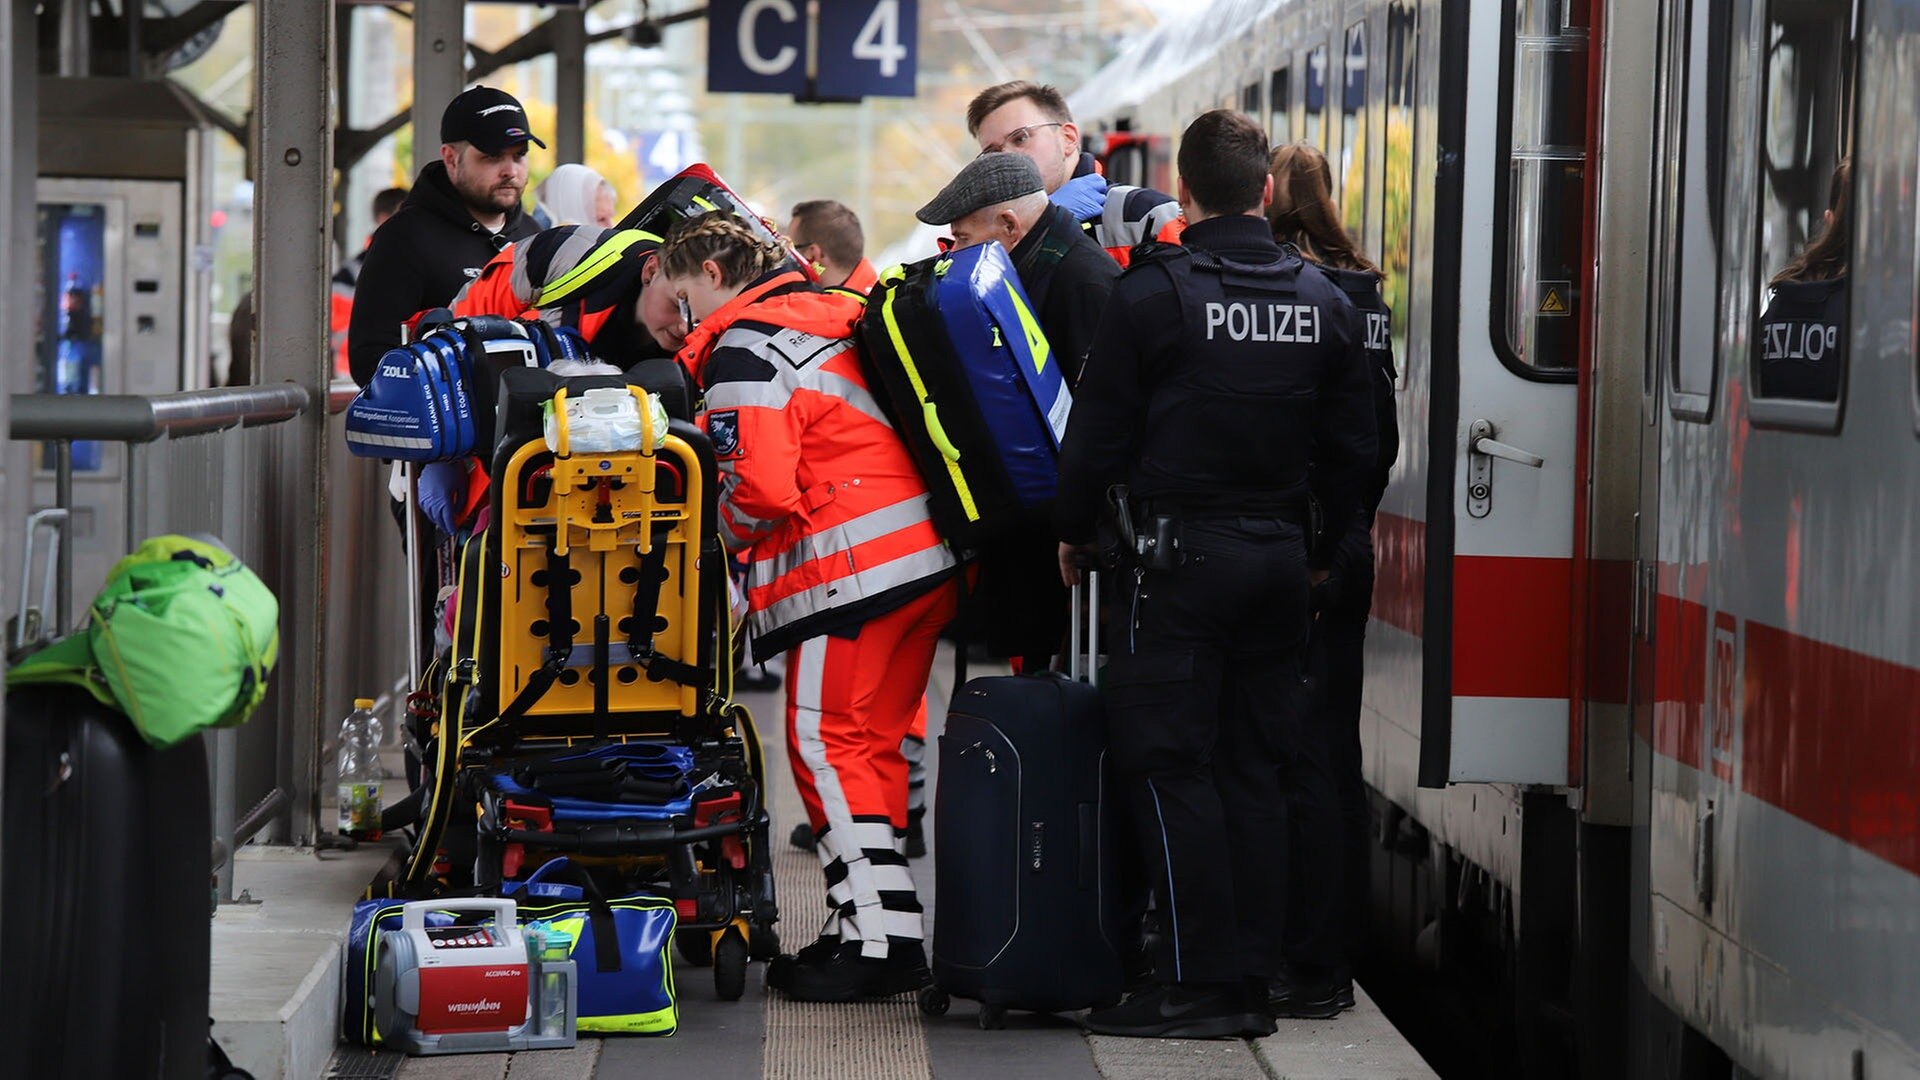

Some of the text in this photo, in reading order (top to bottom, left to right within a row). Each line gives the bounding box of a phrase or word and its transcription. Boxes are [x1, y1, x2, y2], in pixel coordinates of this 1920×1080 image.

[737, 0, 798, 75] C
[852, 0, 907, 77] 4
[649, 131, 680, 174] 4
[1206, 302, 1320, 344] POLIZEI
[1364, 313, 1390, 350] IZE
[383, 365, 411, 379] ZOLL
[447, 998, 501, 1014] WEINMANN
